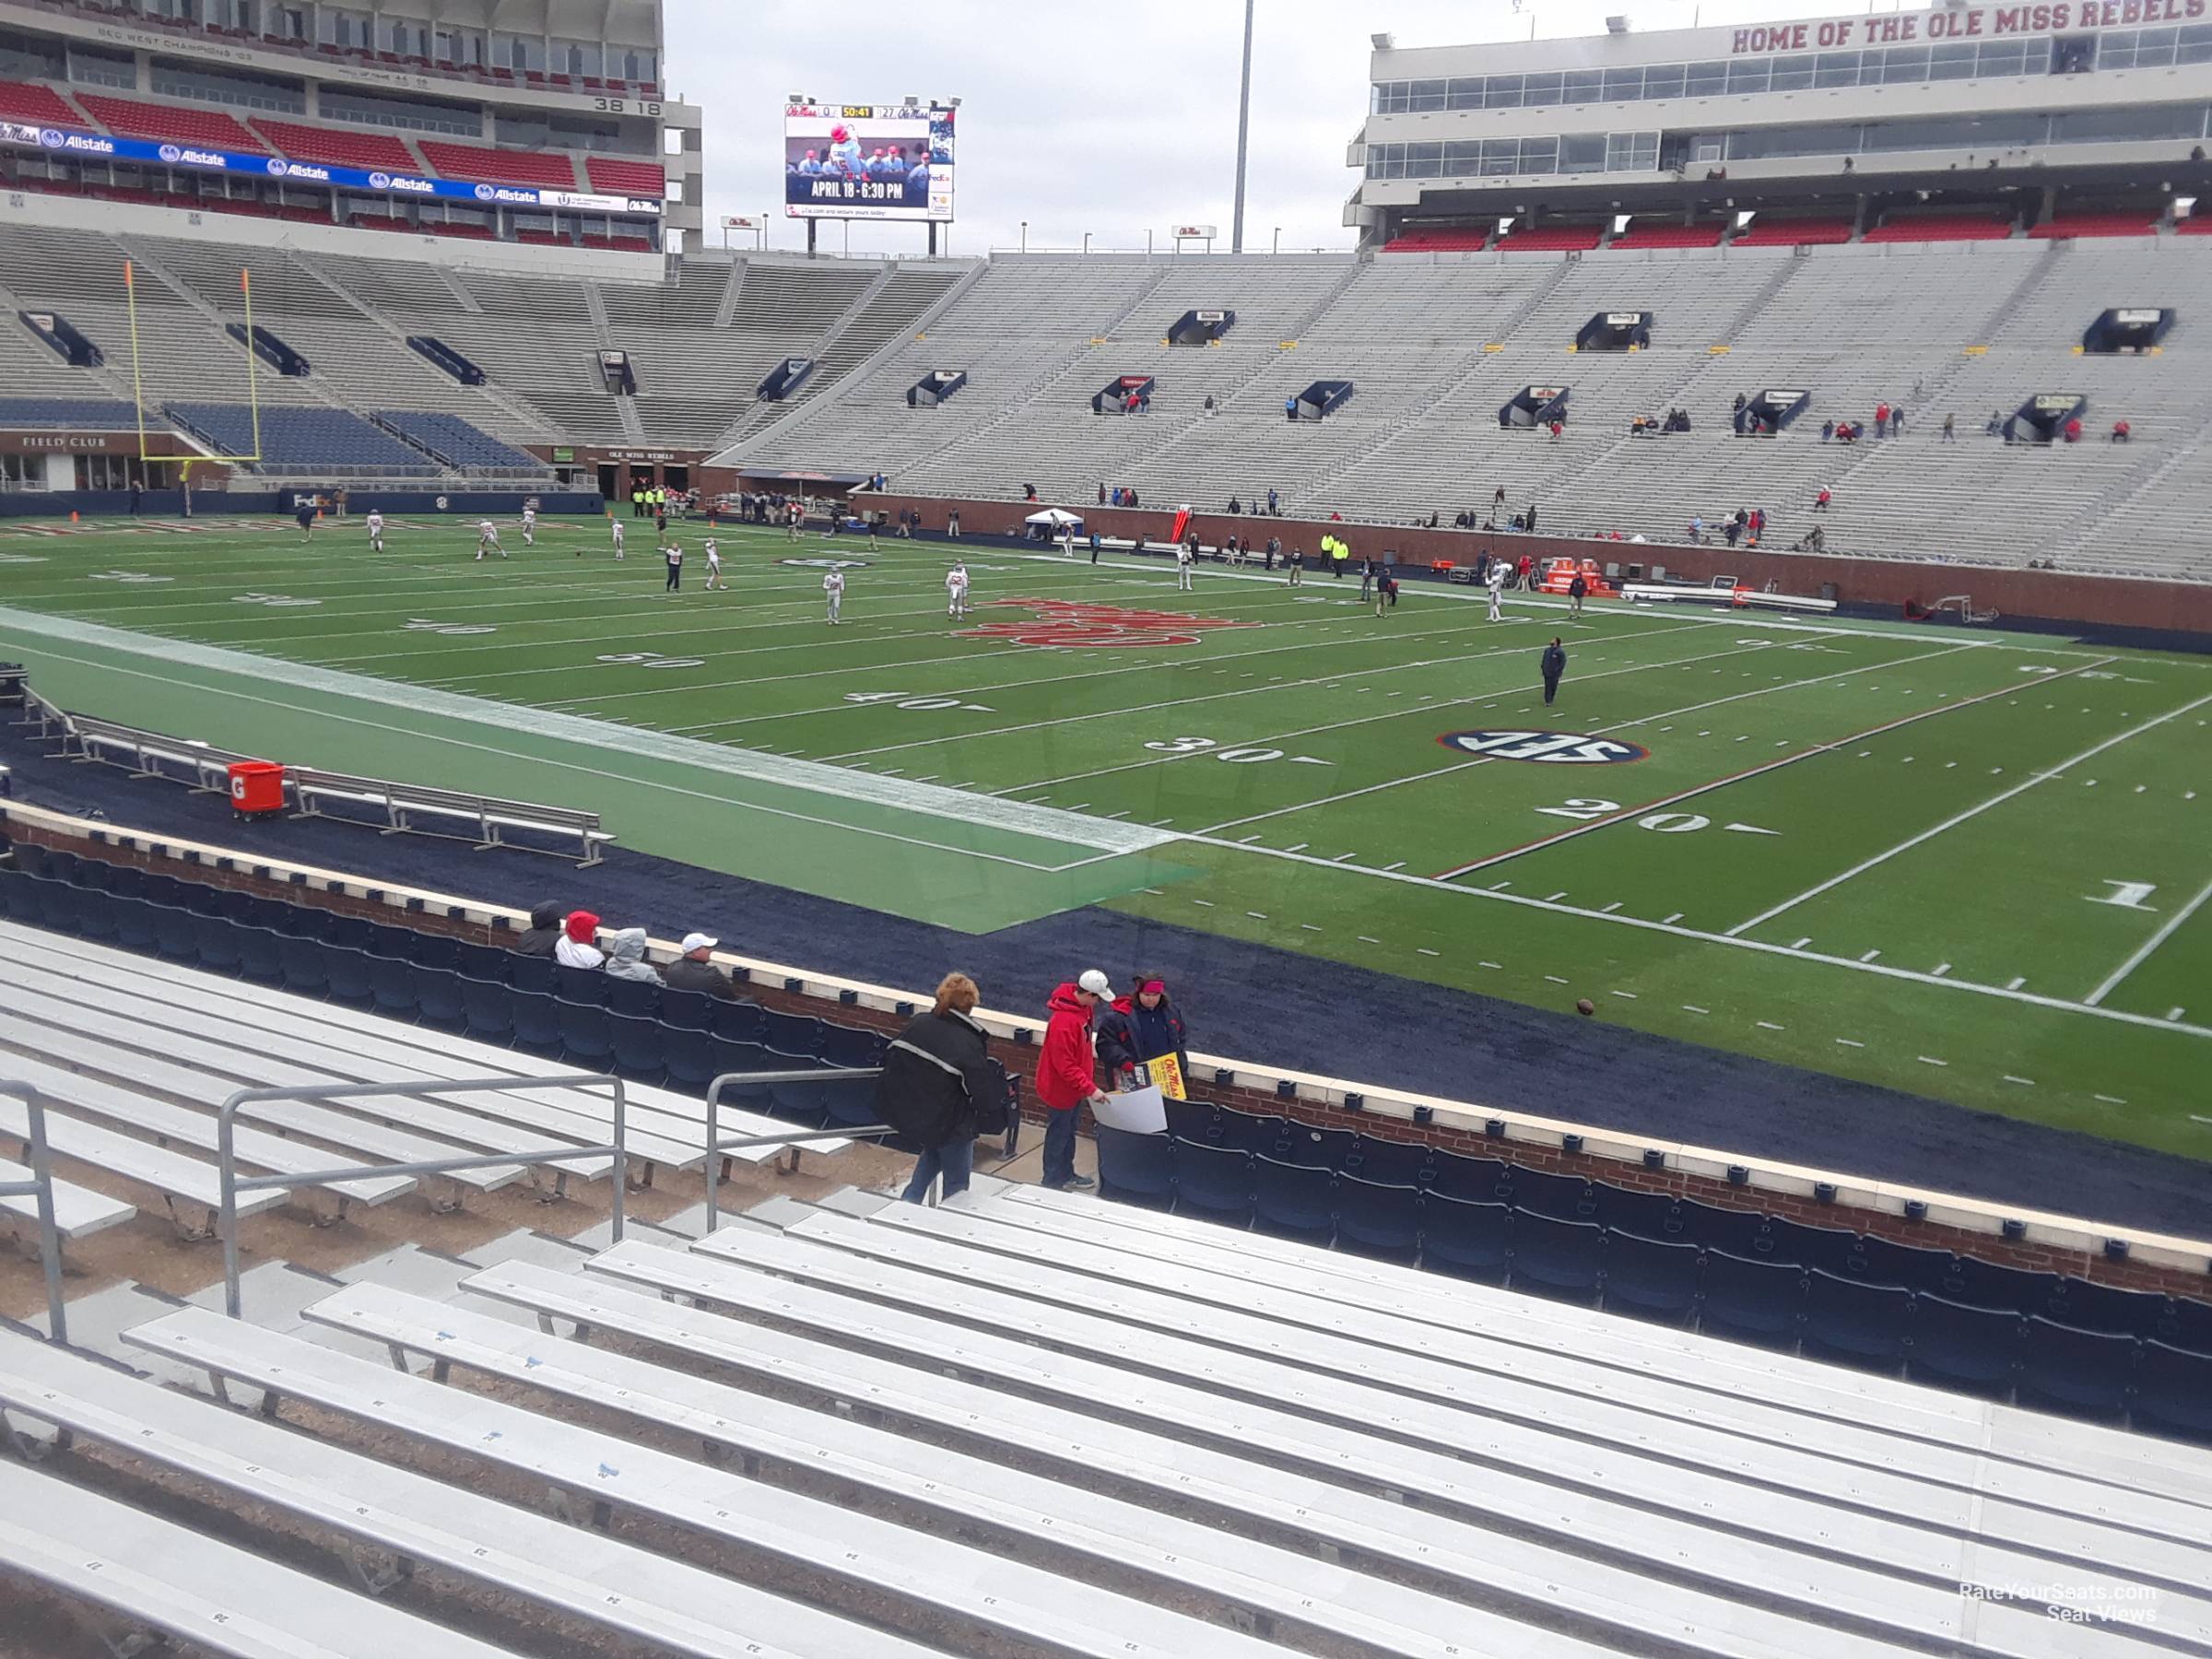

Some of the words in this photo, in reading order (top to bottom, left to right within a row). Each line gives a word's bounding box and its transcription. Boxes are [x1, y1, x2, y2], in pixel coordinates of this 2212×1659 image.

[1733, 24, 1808, 53] HOME
[1818, 20, 1852, 46] OF
[1865, 15, 1919, 43] THE
[1927, 9, 1984, 38] OLE
[1994, 3, 2069, 33] MISS
[2079, 0, 2206, 27] REBELS
[127, 34, 159, 44] WEST
[164, 40, 230, 58] CHAMPIONS
[594, 98, 623, 112] 38
[638, 102, 661, 116] 18
[842, 106, 870, 117] 50:41
[883, 108, 894, 118] 27
[8, 124, 39, 144] Miss
[65, 135, 113, 153] Allstate
[180, 150, 226, 167] Allstate
[287, 164, 330, 181] Allstate
[389, 177, 435, 193] Allstate
[811, 181, 841, 197] APRIL
[843, 182, 854, 198] 18
[861, 182, 885, 199] 6:30
[887, 183, 903, 199] PM
[493, 189, 538, 203] Allstate
[23, 437, 64, 447] FIELD
[69, 437, 106, 447] CLUB
[608, 451, 623, 459] OLE
[293, 494, 331, 507] FedEx
[595, 651, 706, 668] 50
[842, 691, 961, 711] 40
[1144, 735, 1286, 764] 30
[231, 777, 246, 799] G
[1534, 797, 1712, 833] 20
